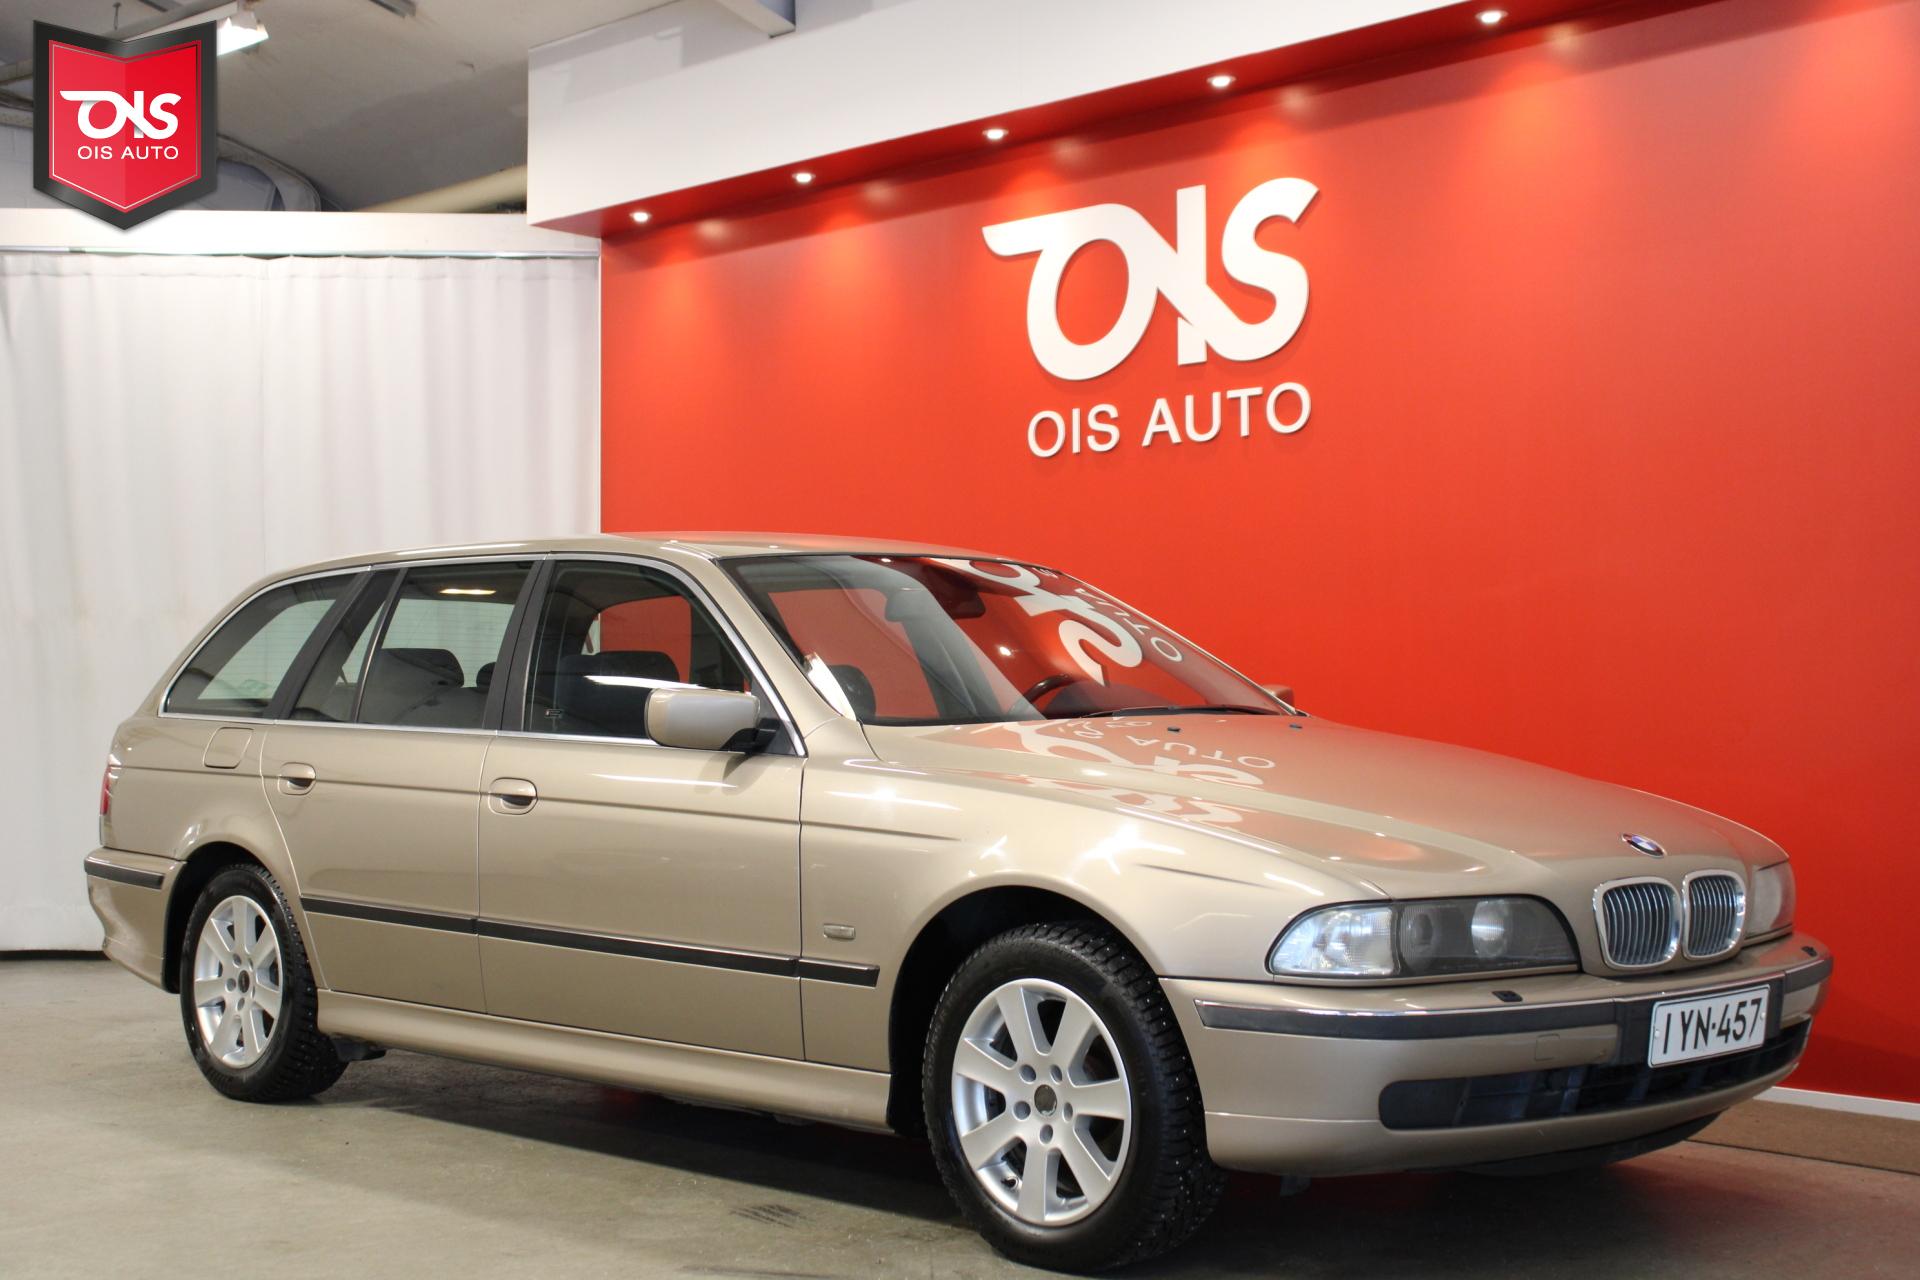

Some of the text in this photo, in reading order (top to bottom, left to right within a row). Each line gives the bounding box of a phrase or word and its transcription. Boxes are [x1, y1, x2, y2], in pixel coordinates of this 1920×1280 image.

[1027, 382, 1311, 458] OIS AUTO
[1663, 998, 1762, 1054] IYN-457
